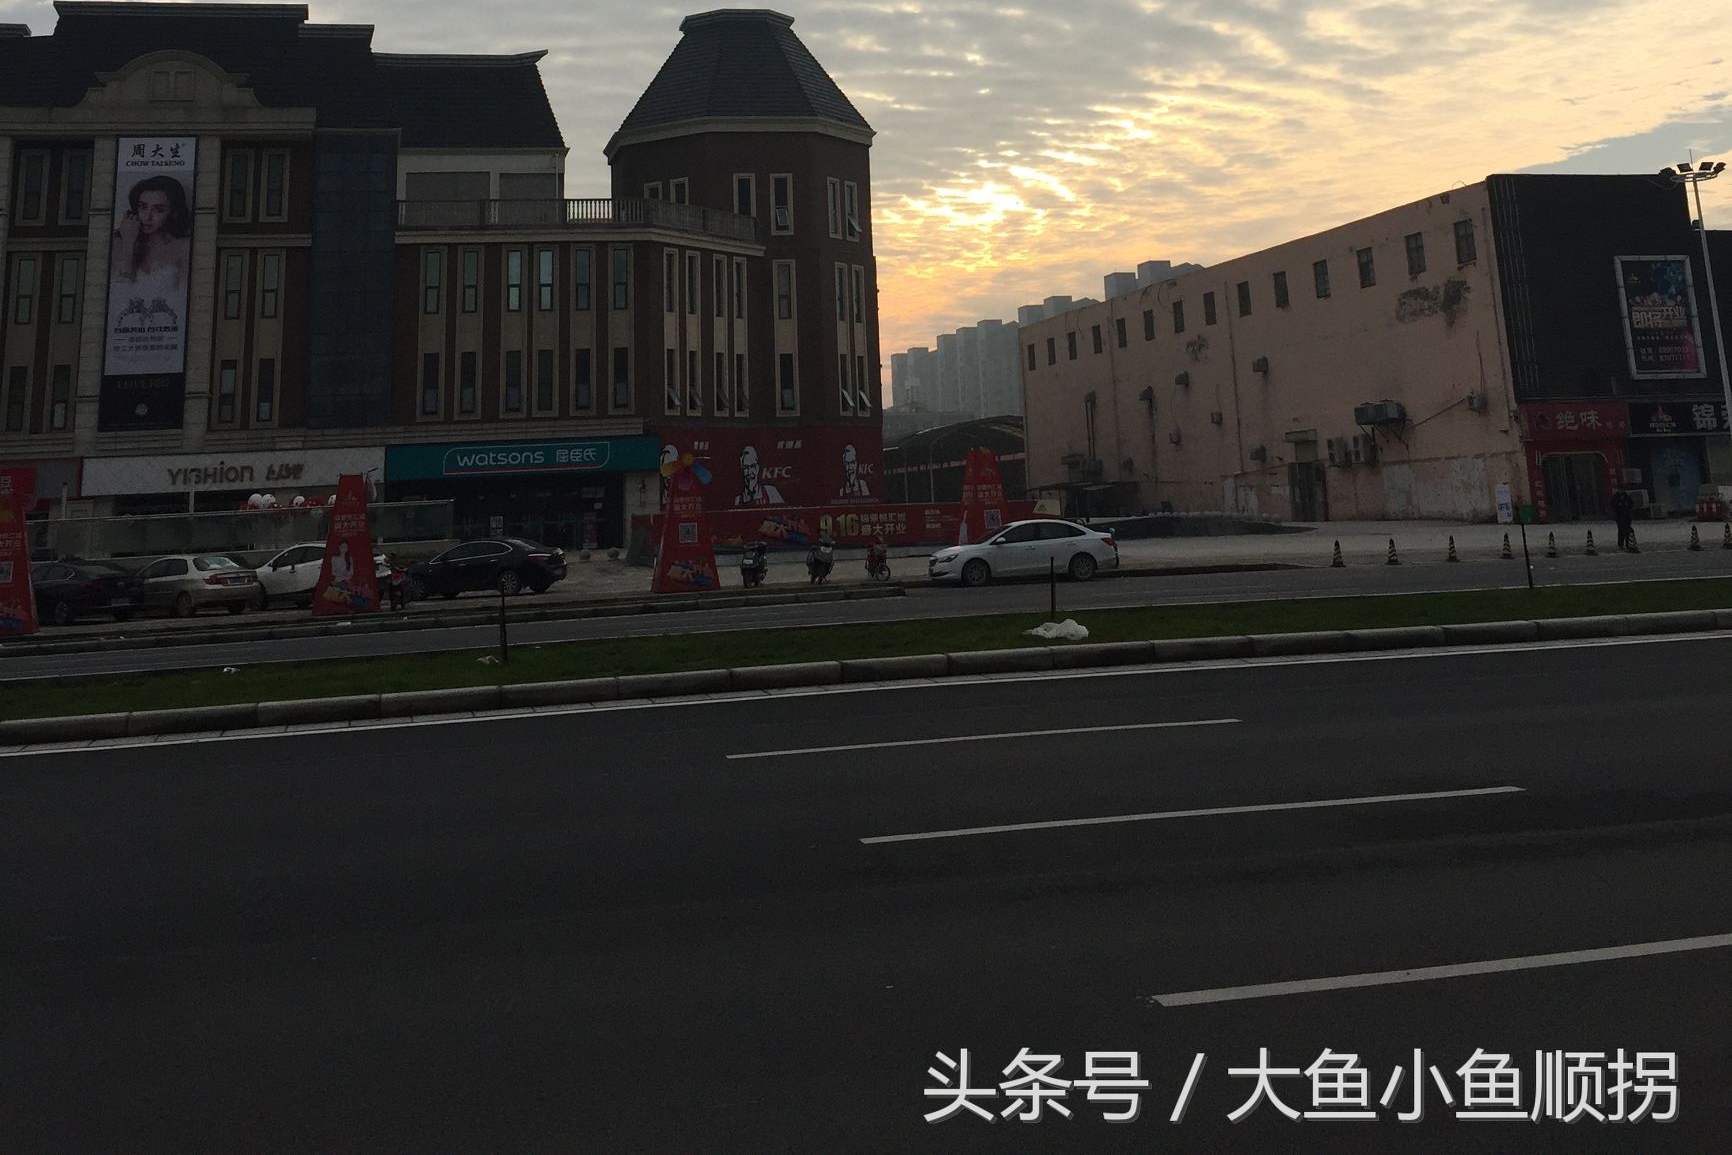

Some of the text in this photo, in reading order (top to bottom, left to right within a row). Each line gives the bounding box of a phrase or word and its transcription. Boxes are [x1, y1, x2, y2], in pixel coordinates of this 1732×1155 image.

[131, 143, 180, 158] 周大生
[1555, 410, 1602, 431] 绝味
[457, 448, 597, 467] watsons 屈臣氏
[761, 466, 793, 479] KFC
[858, 463, 874, 474] KFC
[861, 523, 906, 535] 盛大开业
